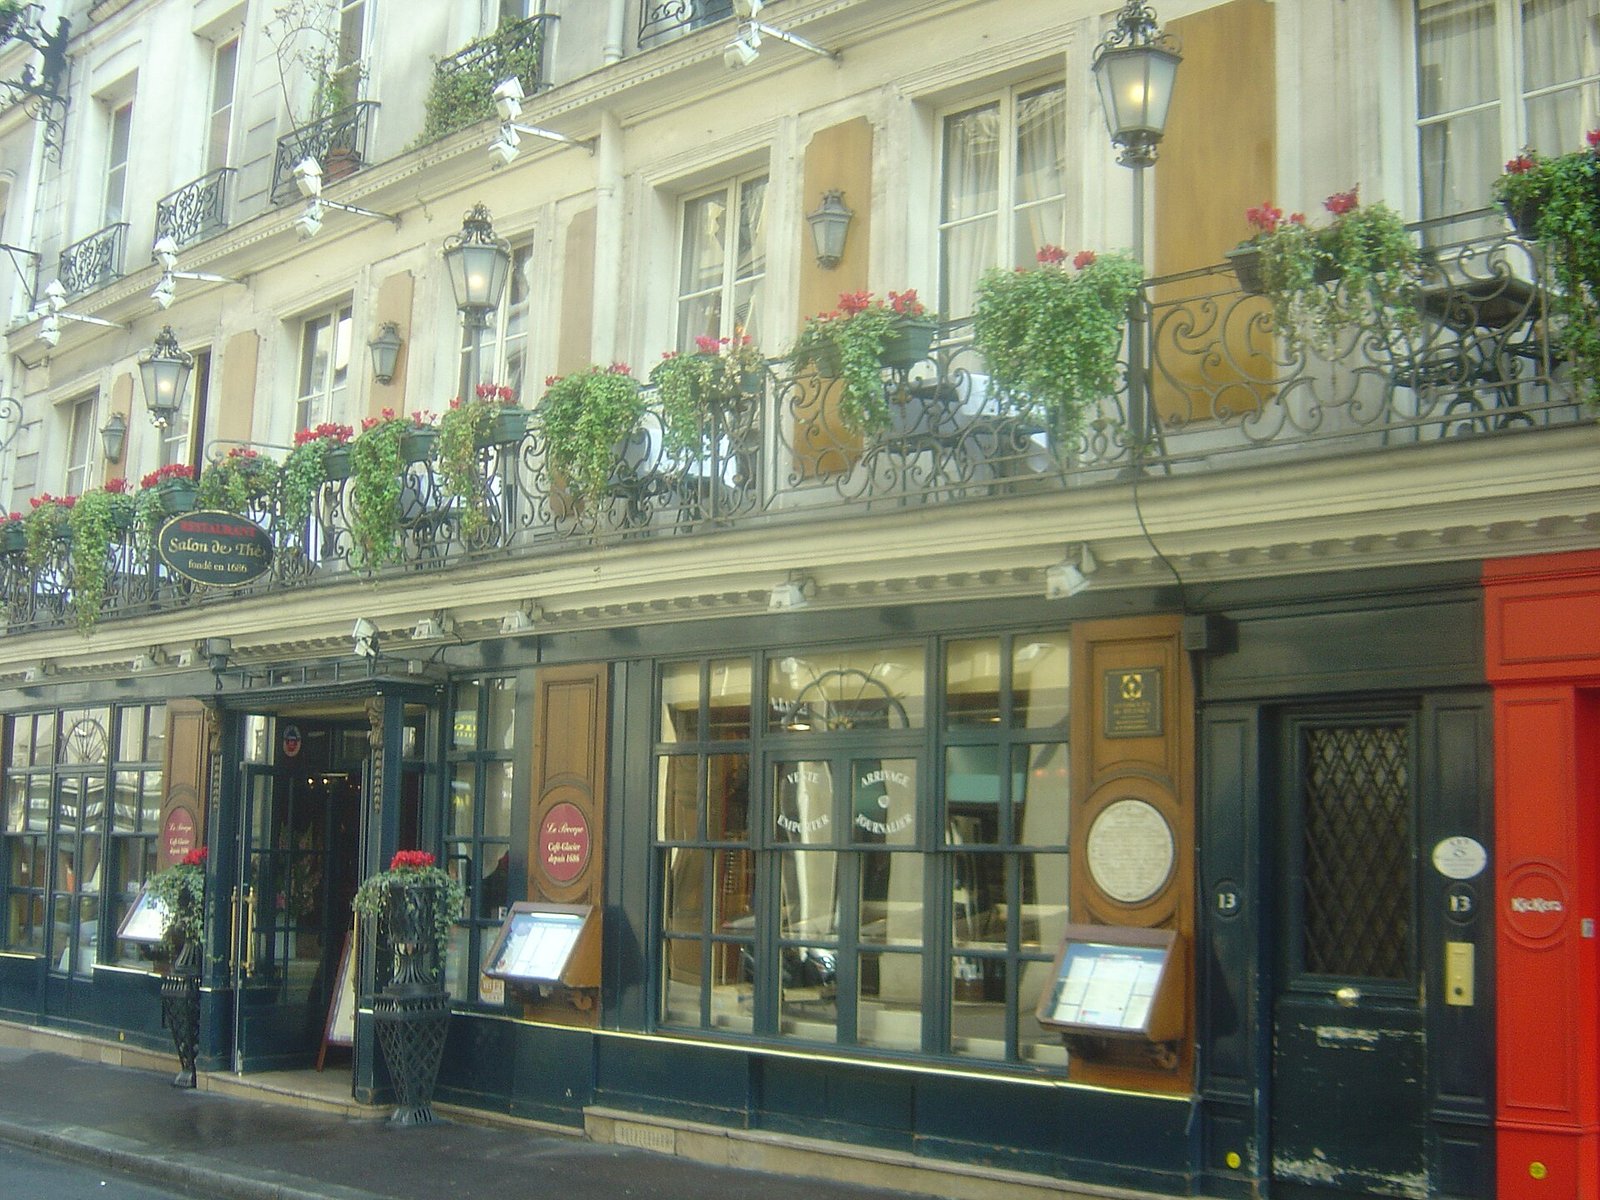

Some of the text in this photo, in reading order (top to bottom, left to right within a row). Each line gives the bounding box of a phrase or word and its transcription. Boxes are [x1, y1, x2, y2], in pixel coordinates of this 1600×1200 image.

[168, 537, 209, 553] Salon
[211, 539, 232, 554] de
[213, 563, 224, 571] en
[861, 769, 910, 788] ARRIVAGE
[1218, 892, 1236, 908] 13
[1449, 895, 1471, 912] 13
